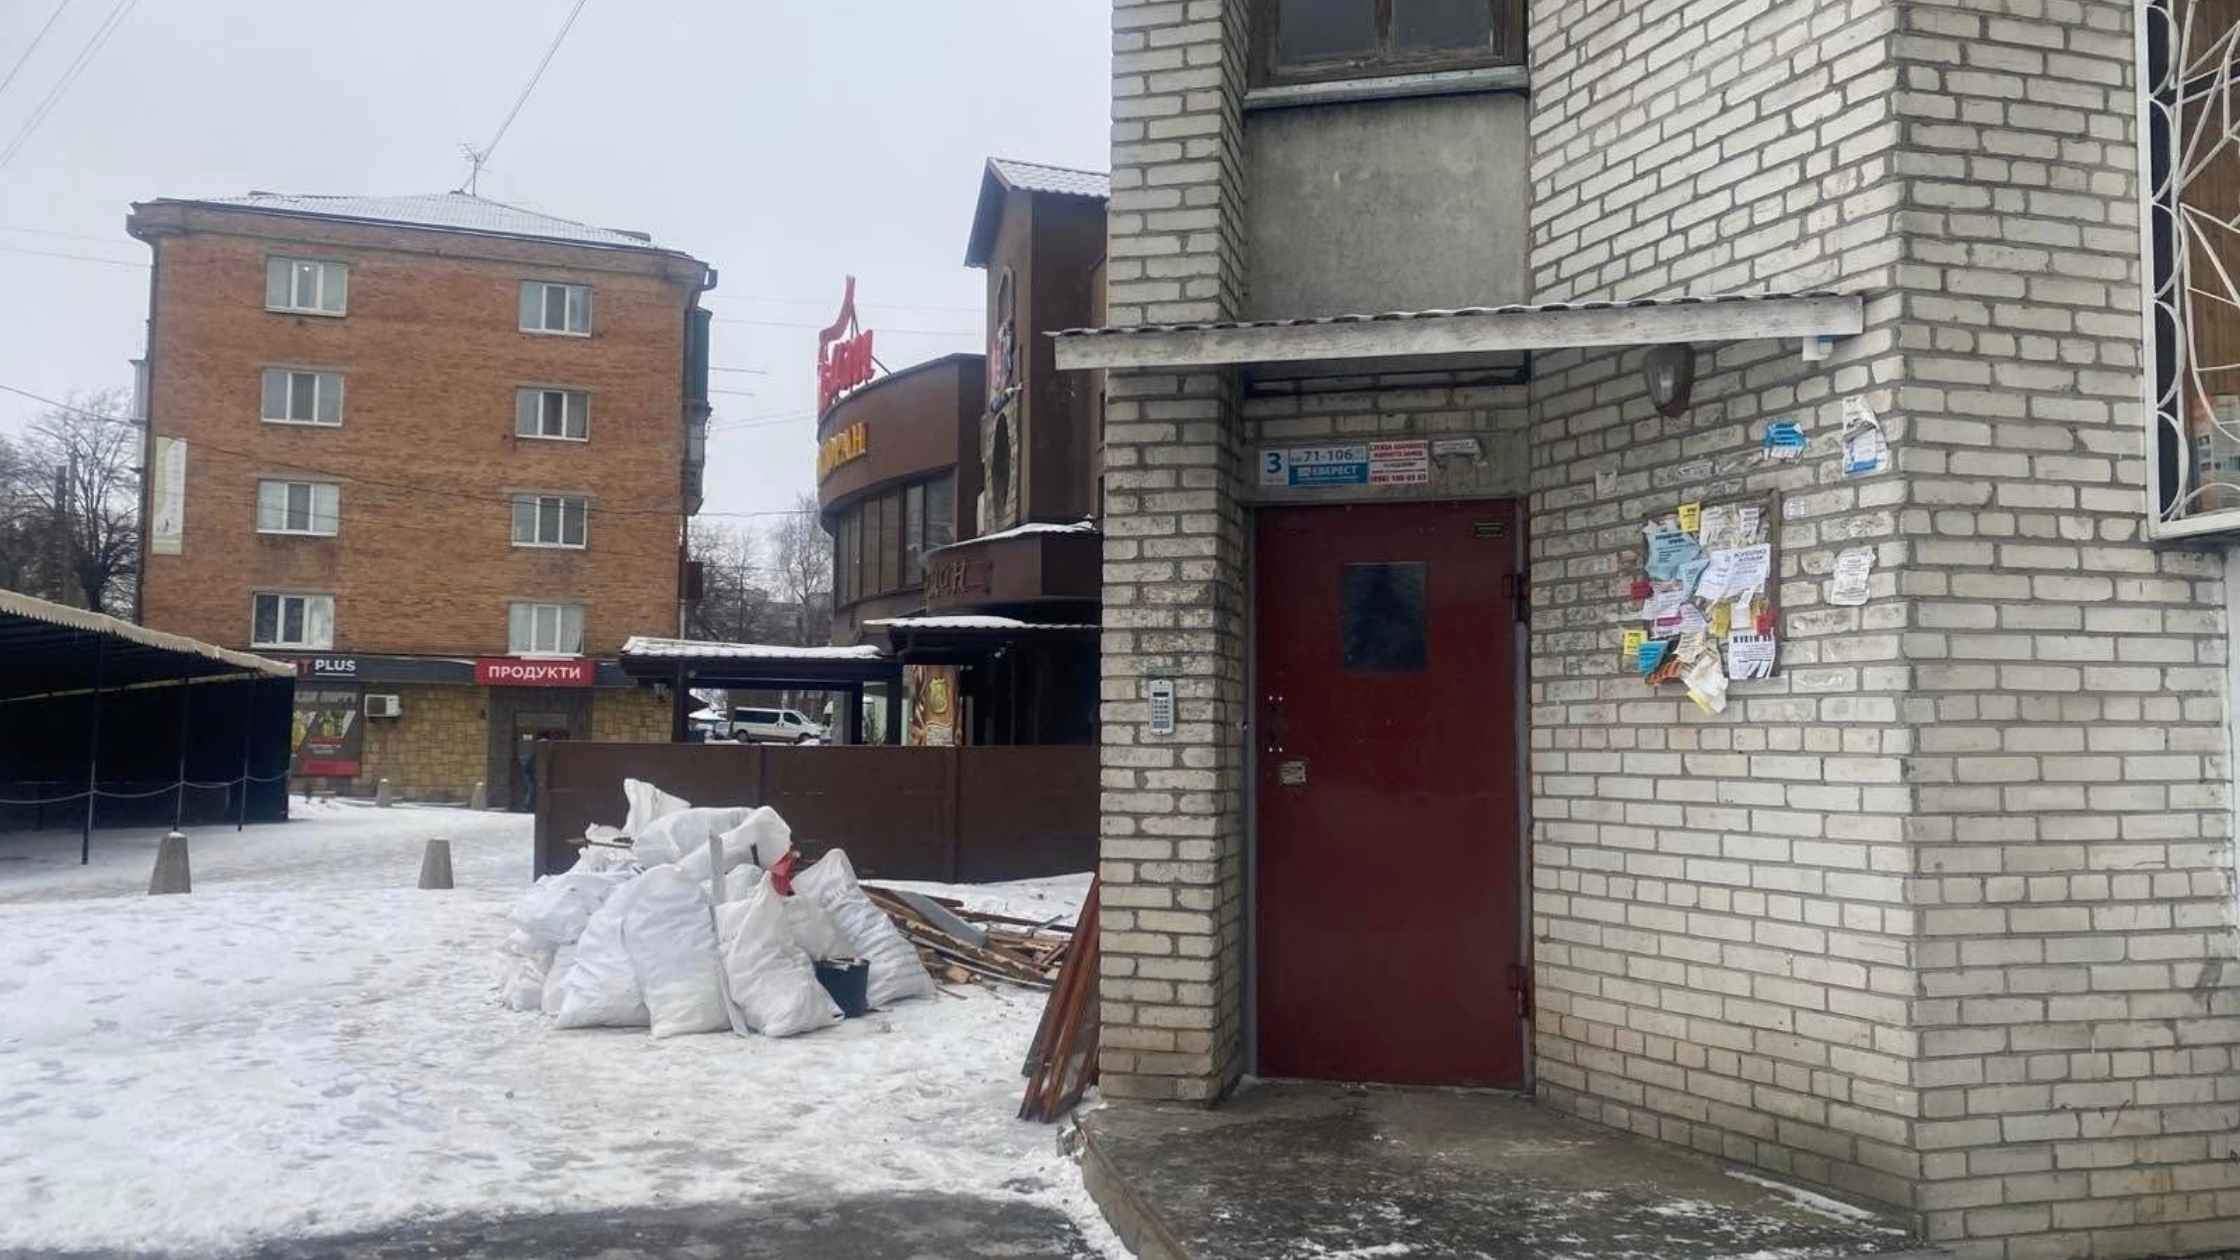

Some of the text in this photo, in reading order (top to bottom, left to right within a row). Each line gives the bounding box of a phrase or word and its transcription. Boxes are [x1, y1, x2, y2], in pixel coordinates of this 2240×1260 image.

[1266, 452, 1282, 473] 3
[314, 659, 357, 672] PLUS
[488, 665, 581, 680] ПРОДУКТИ
